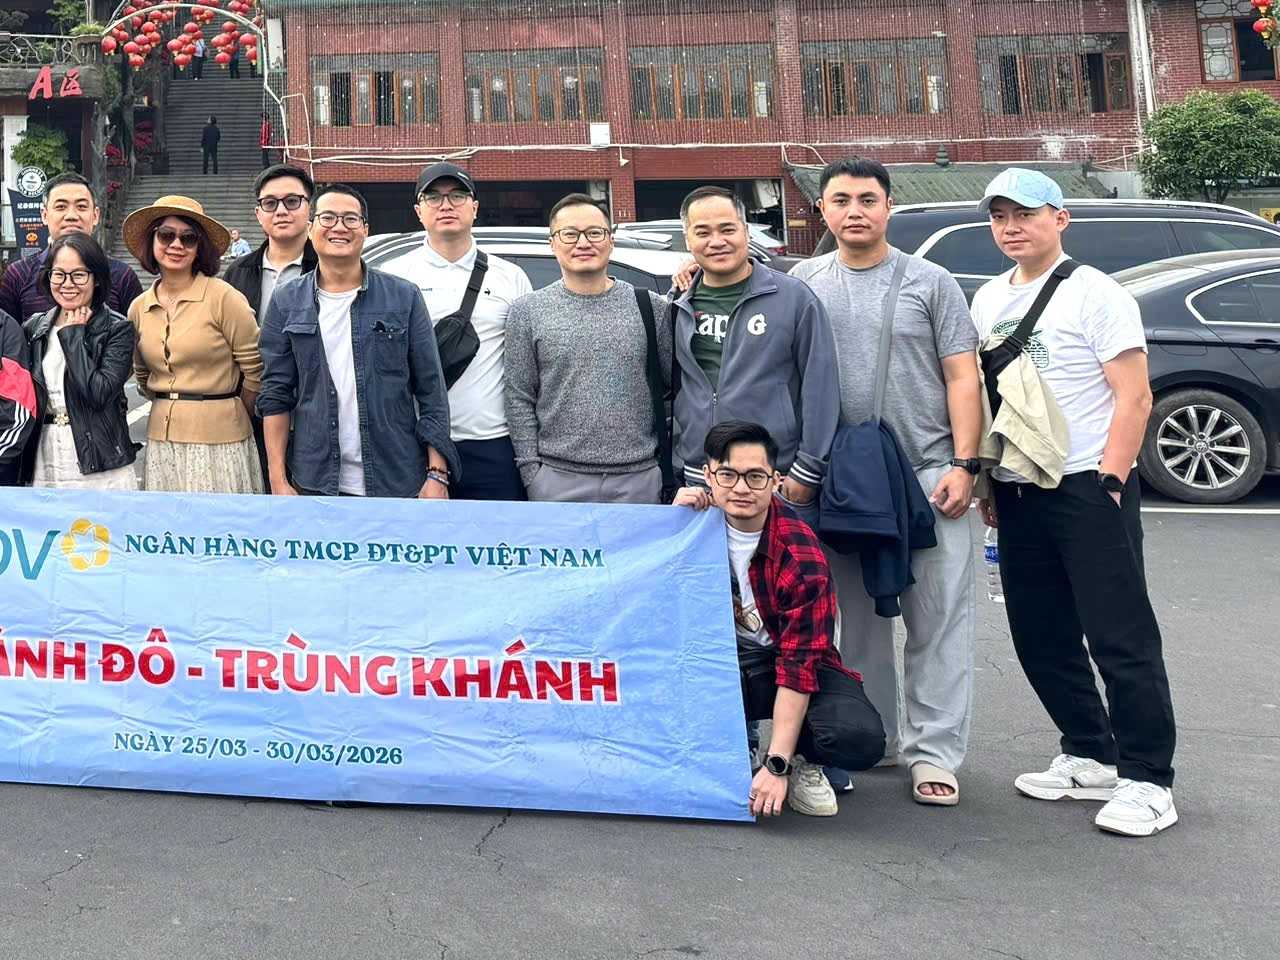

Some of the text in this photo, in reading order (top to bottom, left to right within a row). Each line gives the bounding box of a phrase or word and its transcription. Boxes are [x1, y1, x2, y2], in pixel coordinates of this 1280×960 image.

[125, 530, 605, 570] NGÂN HÀNG TMCP ĐT&PT VIỆT NAM
[97, 627, 176, 686] ĐÔ
[215, 633, 398, 695] TRÙNG
[411, 639, 618, 702] KHÁNH
[113, 731, 175, 752] NGÀY
[182, 736, 247, 759] 25/03
[265, 741, 404, 766] 30/03/2026
